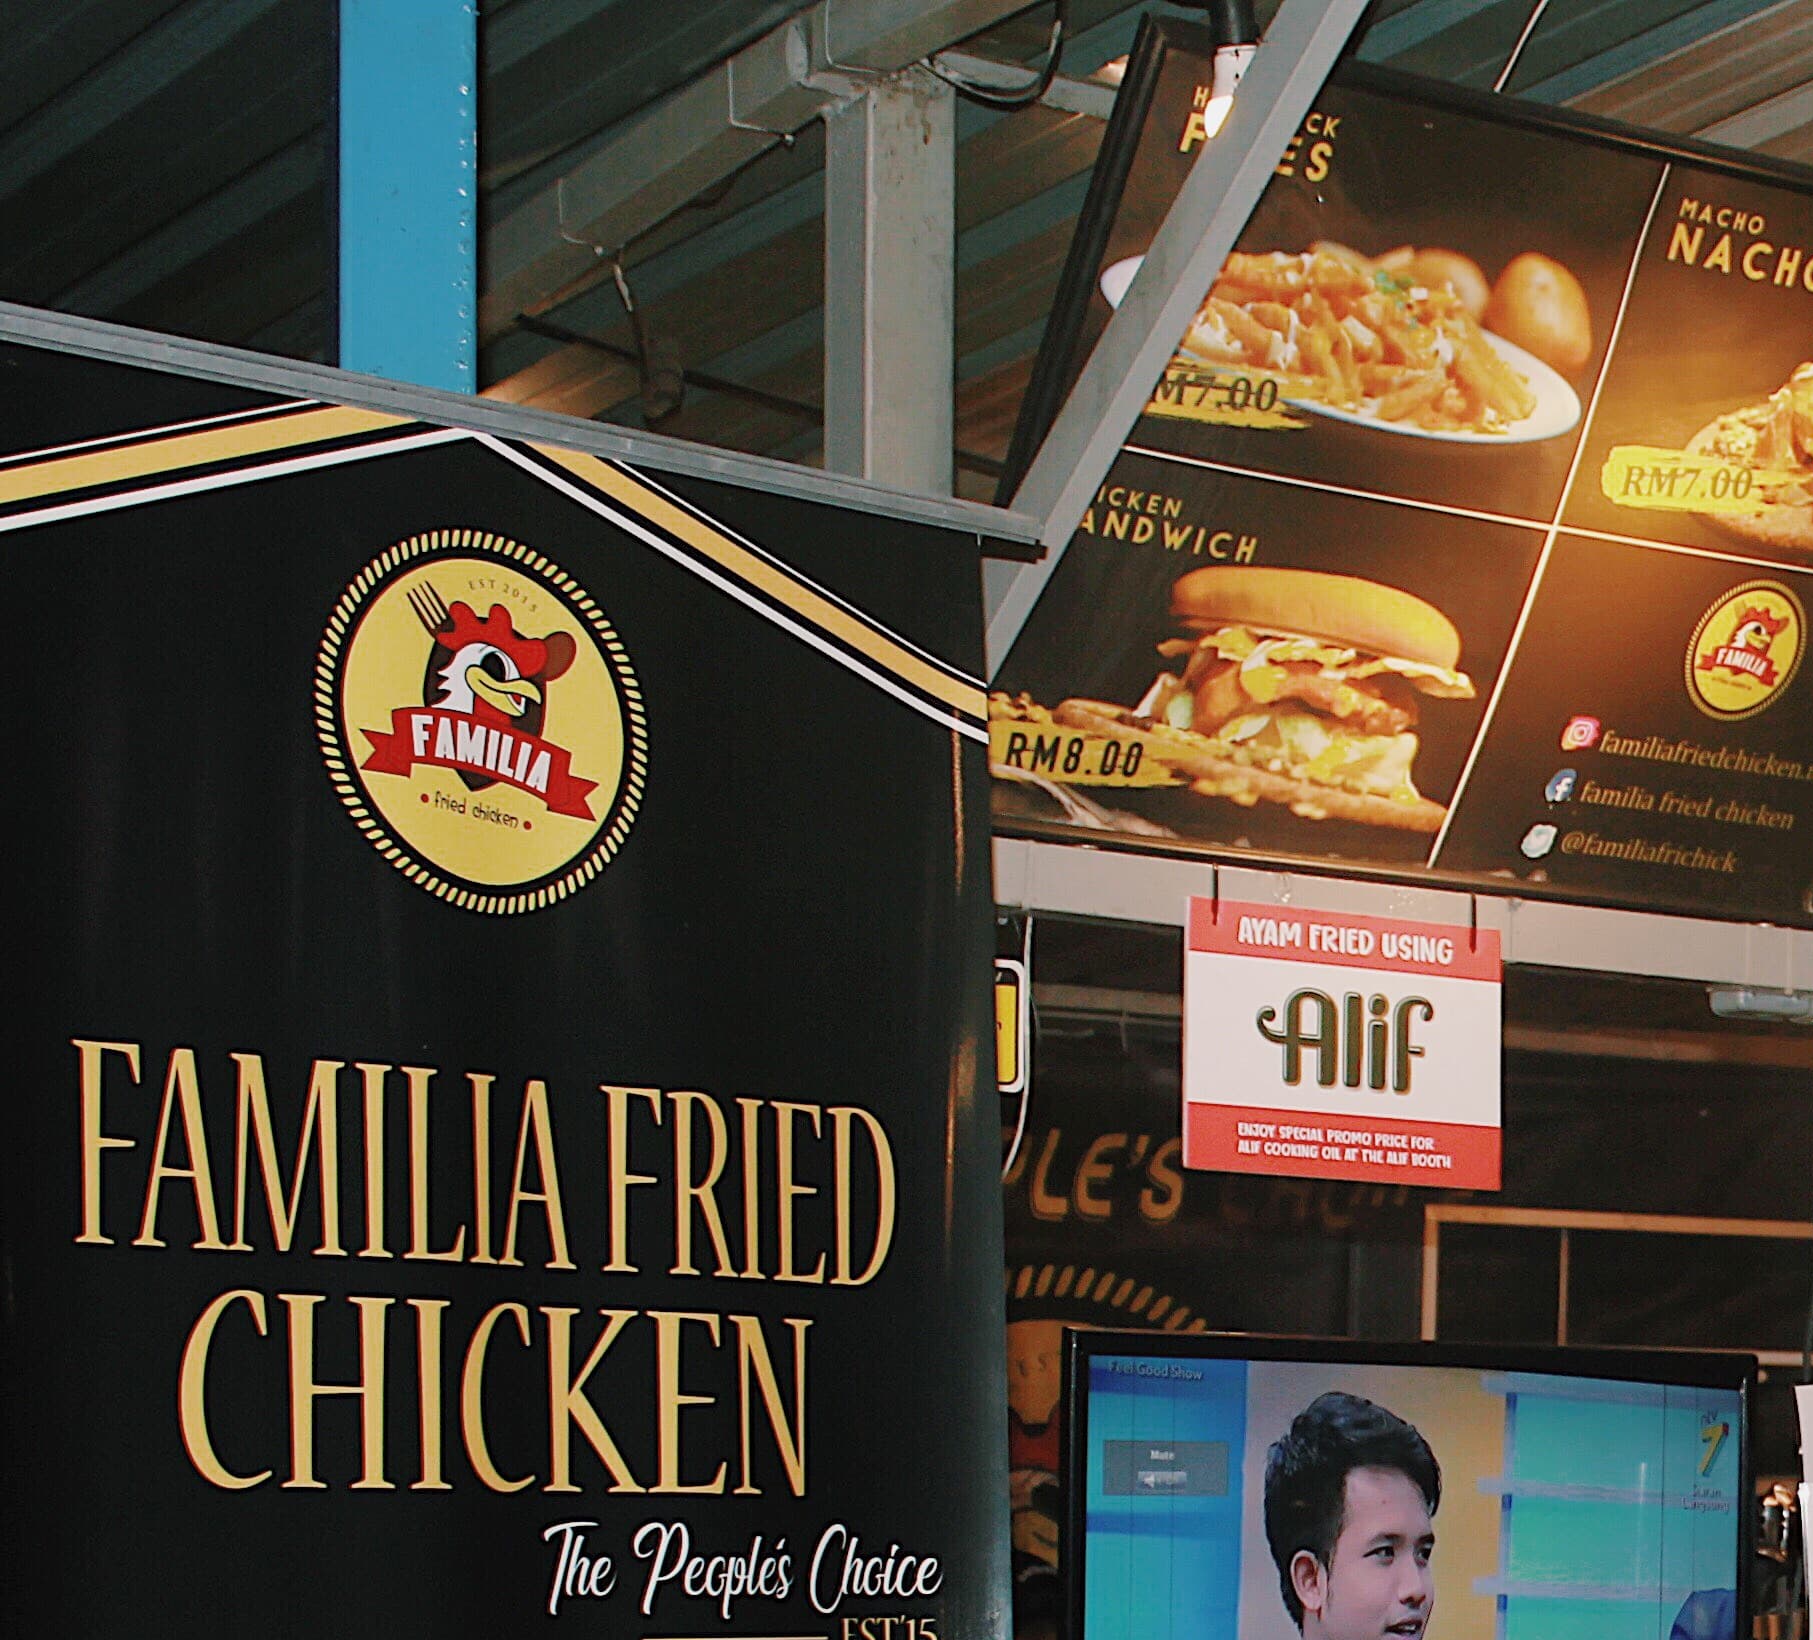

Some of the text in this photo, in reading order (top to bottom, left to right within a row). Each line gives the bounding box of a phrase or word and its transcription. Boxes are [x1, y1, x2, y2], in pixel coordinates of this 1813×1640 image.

[1679, 198, 1766, 235] MACHO
[1097, 485, 1183, 518] ICKEN
[1621, 465, 1752, 500] RM7.00
[1077, 507, 1258, 564] ANDWICH
[1715, 647, 1769, 677] FAMILIA
[410, 713, 552, 794] FAMILIA
[1004, 731, 1144, 777] RM8.00
[434, 790, 519, 828] fried chicken
[1579, 779, 1795, 831] familia fried chicken
[1561, 830, 1739, 873] @familiafrichick
[1238, 915, 1455, 966] AYAM FRIED USING
[1256, 987, 1434, 1095] Alif
[1237, 1121, 1435, 1151] ENJOY SPECIAL PROMO PRICE FOR
[1237, 1139, 1452, 1170] ALIF COOKING OIL AT THE ALIF BOOTH
[71, 1037, 898, 1287] FAMILIA FRIED
[177, 1288, 815, 1498] CHICKEN
[543, 1520, 944, 1620] The People's Choice
